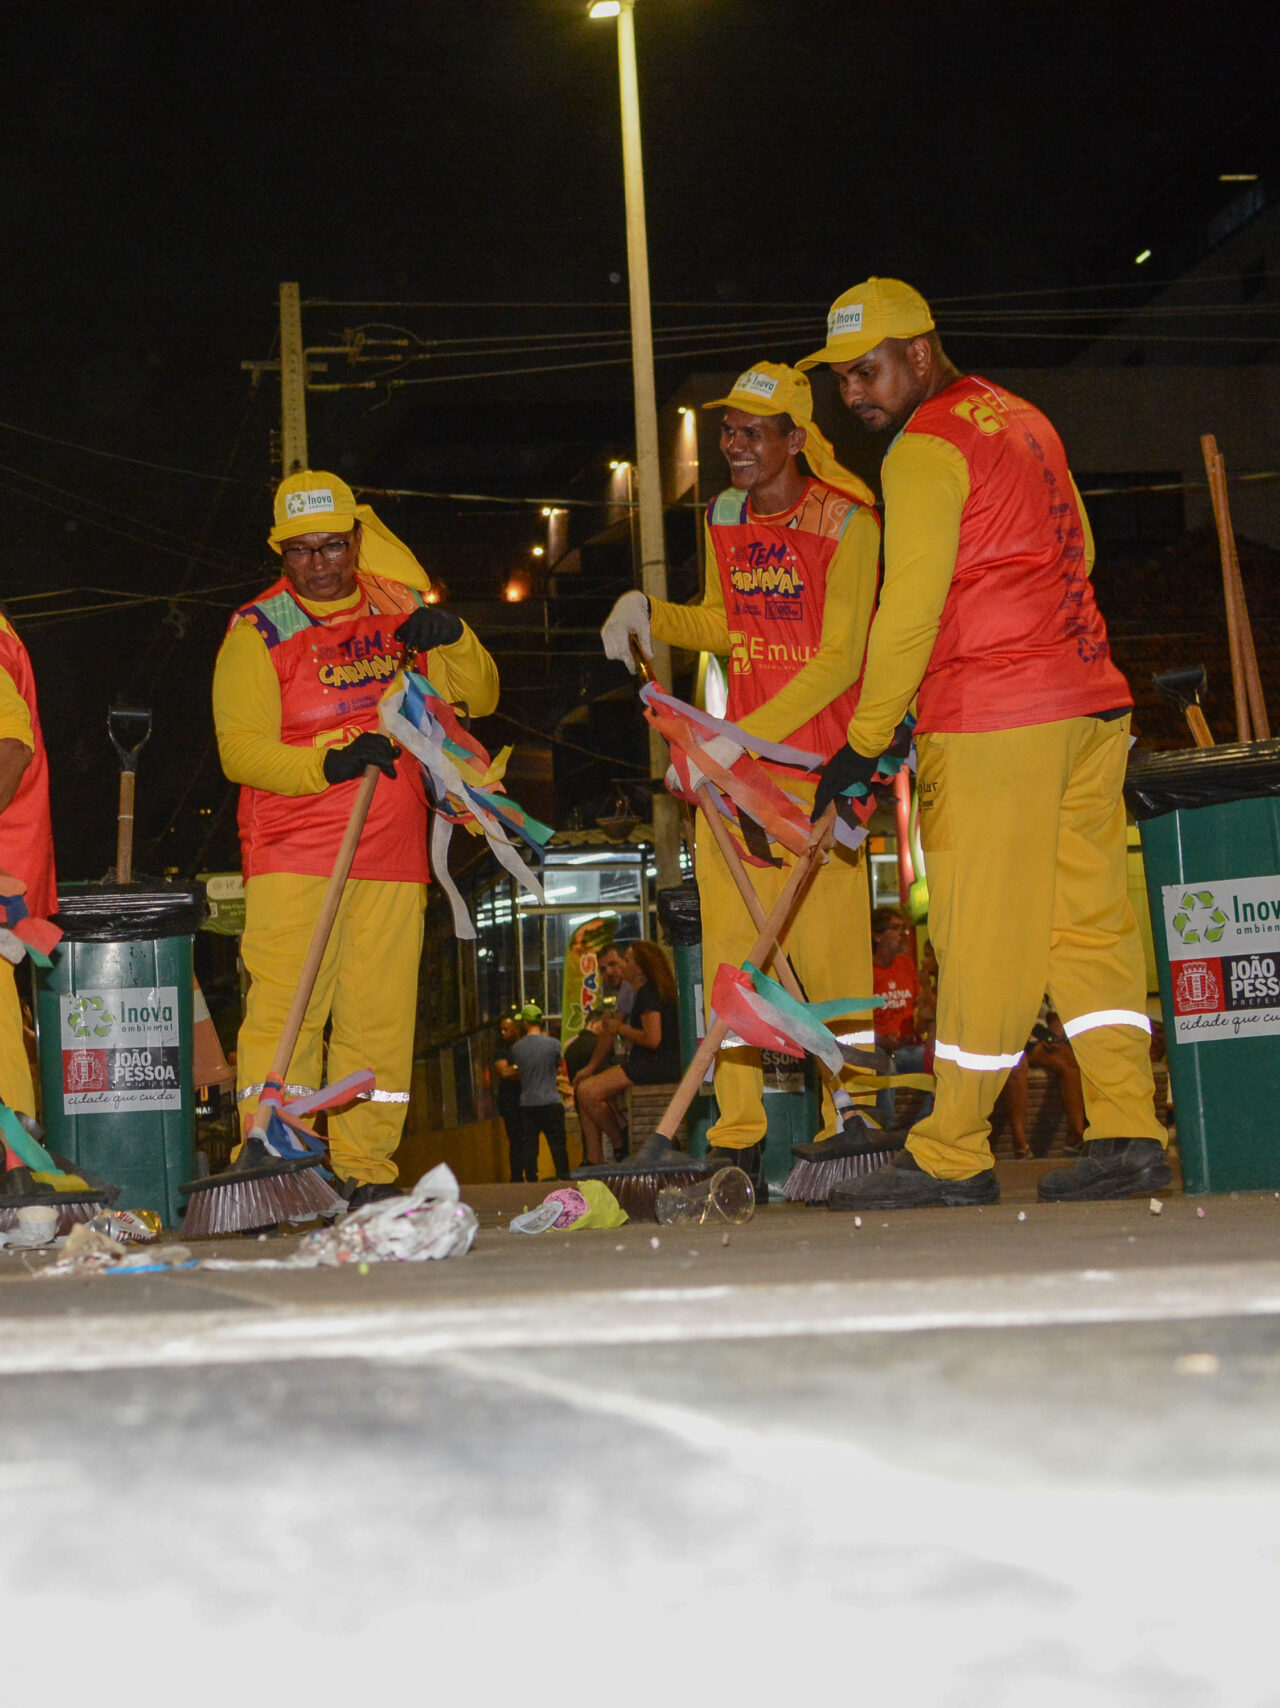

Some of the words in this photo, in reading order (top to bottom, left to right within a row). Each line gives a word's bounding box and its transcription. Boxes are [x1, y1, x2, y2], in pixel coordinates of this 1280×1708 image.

[836, 312, 860, 324] Inova
[752, 376, 774, 391] Inova
[307, 495, 332, 505] Inova
[748, 541, 786, 566] TEM
[337, 630, 384, 659] TEM
[750, 636, 818, 662] Emlu
[318, 651, 402, 687] CARNAV
[1232, 895, 1280, 923] Inov
[1236, 923, 1280, 935] ambien
[1230, 954, 1276, 981] JOÃO
[1231, 976, 1280, 999] PESS
[1232, 997, 1280, 1007] PREFEI
[121, 1001, 173, 1024] Inova
[121, 1024, 173, 1033] ambiental
[1180, 1013, 1230, 1031] cidade
[1232, 1015, 1261, 1035] que
[114, 1049, 152, 1068] JOÃO
[761, 1048, 799, 1066] SSOA
[114, 1065, 176, 1082] PESSOA
[68, 1093, 112, 1105] cidade
[112, 1092, 138, 1109] que
[140, 1089, 176, 1101] cuida
